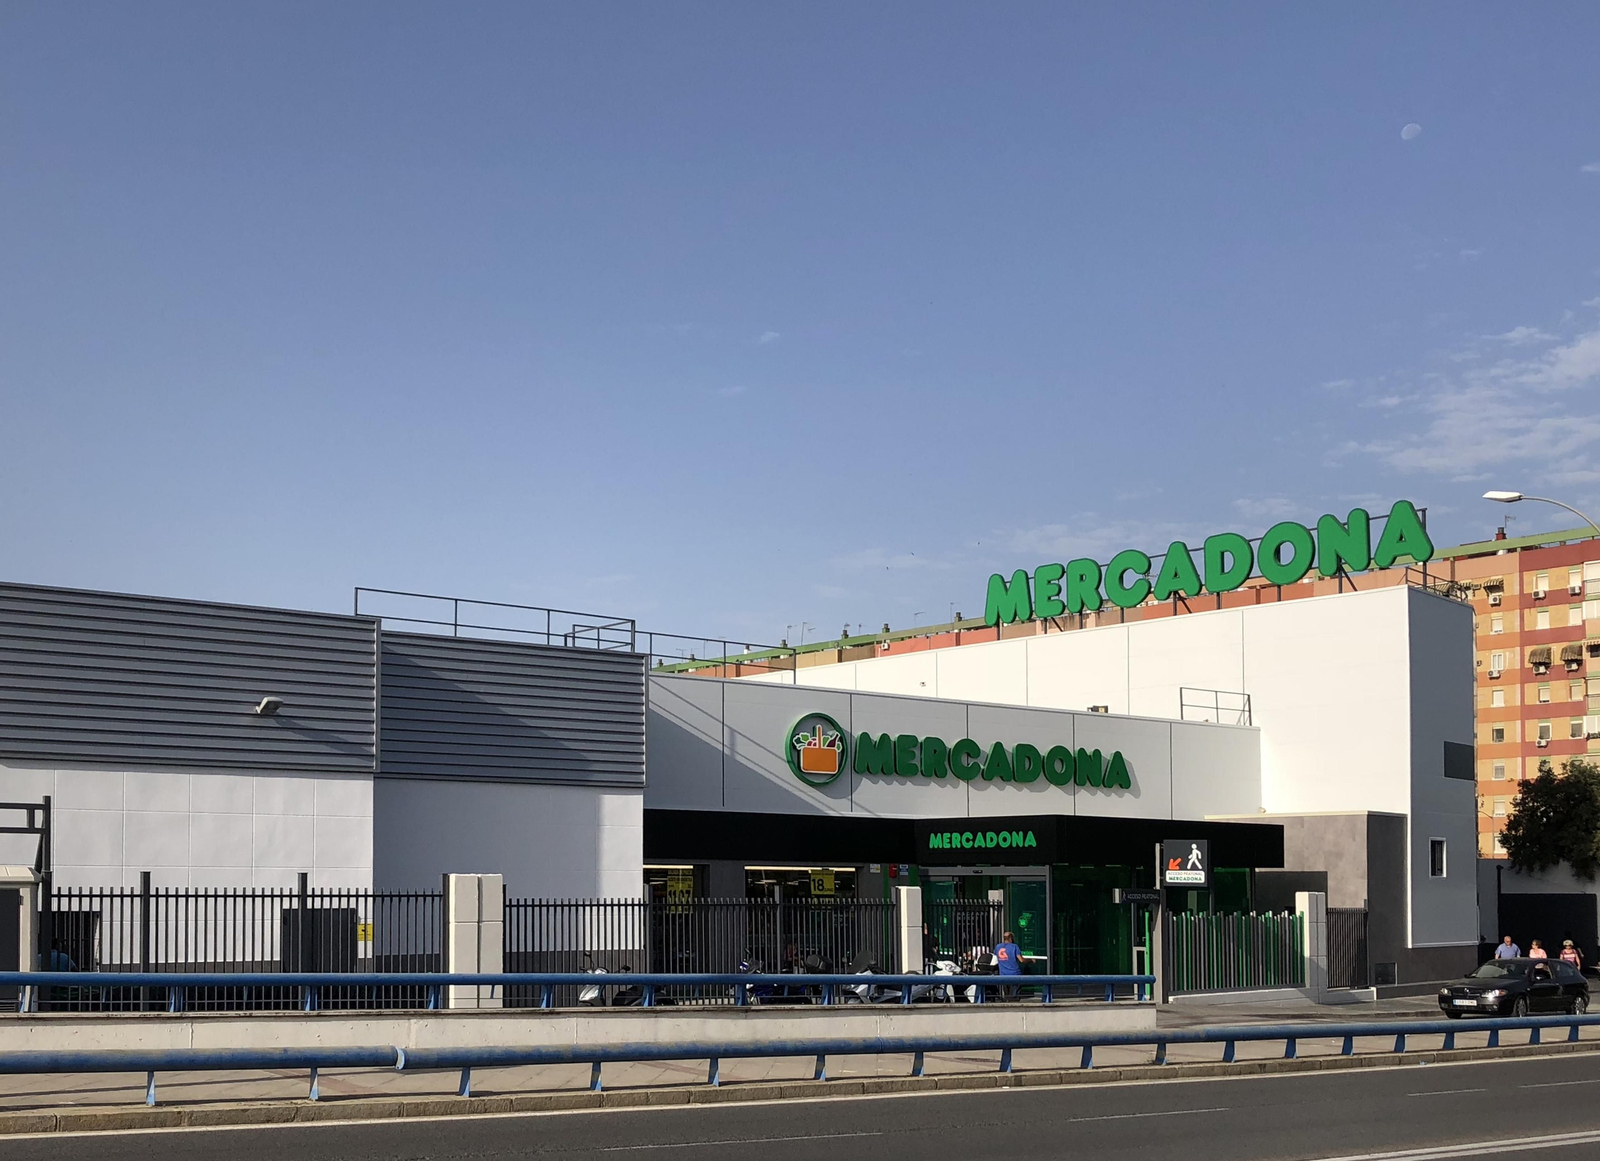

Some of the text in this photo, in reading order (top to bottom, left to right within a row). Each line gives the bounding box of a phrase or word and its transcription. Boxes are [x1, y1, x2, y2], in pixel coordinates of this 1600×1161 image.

[984, 500, 1434, 626] MERCADONA
[854, 732, 1131, 789] MERCADONA
[929, 831, 1037, 848] MERCADONA
[811, 878, 825, 892] 18
